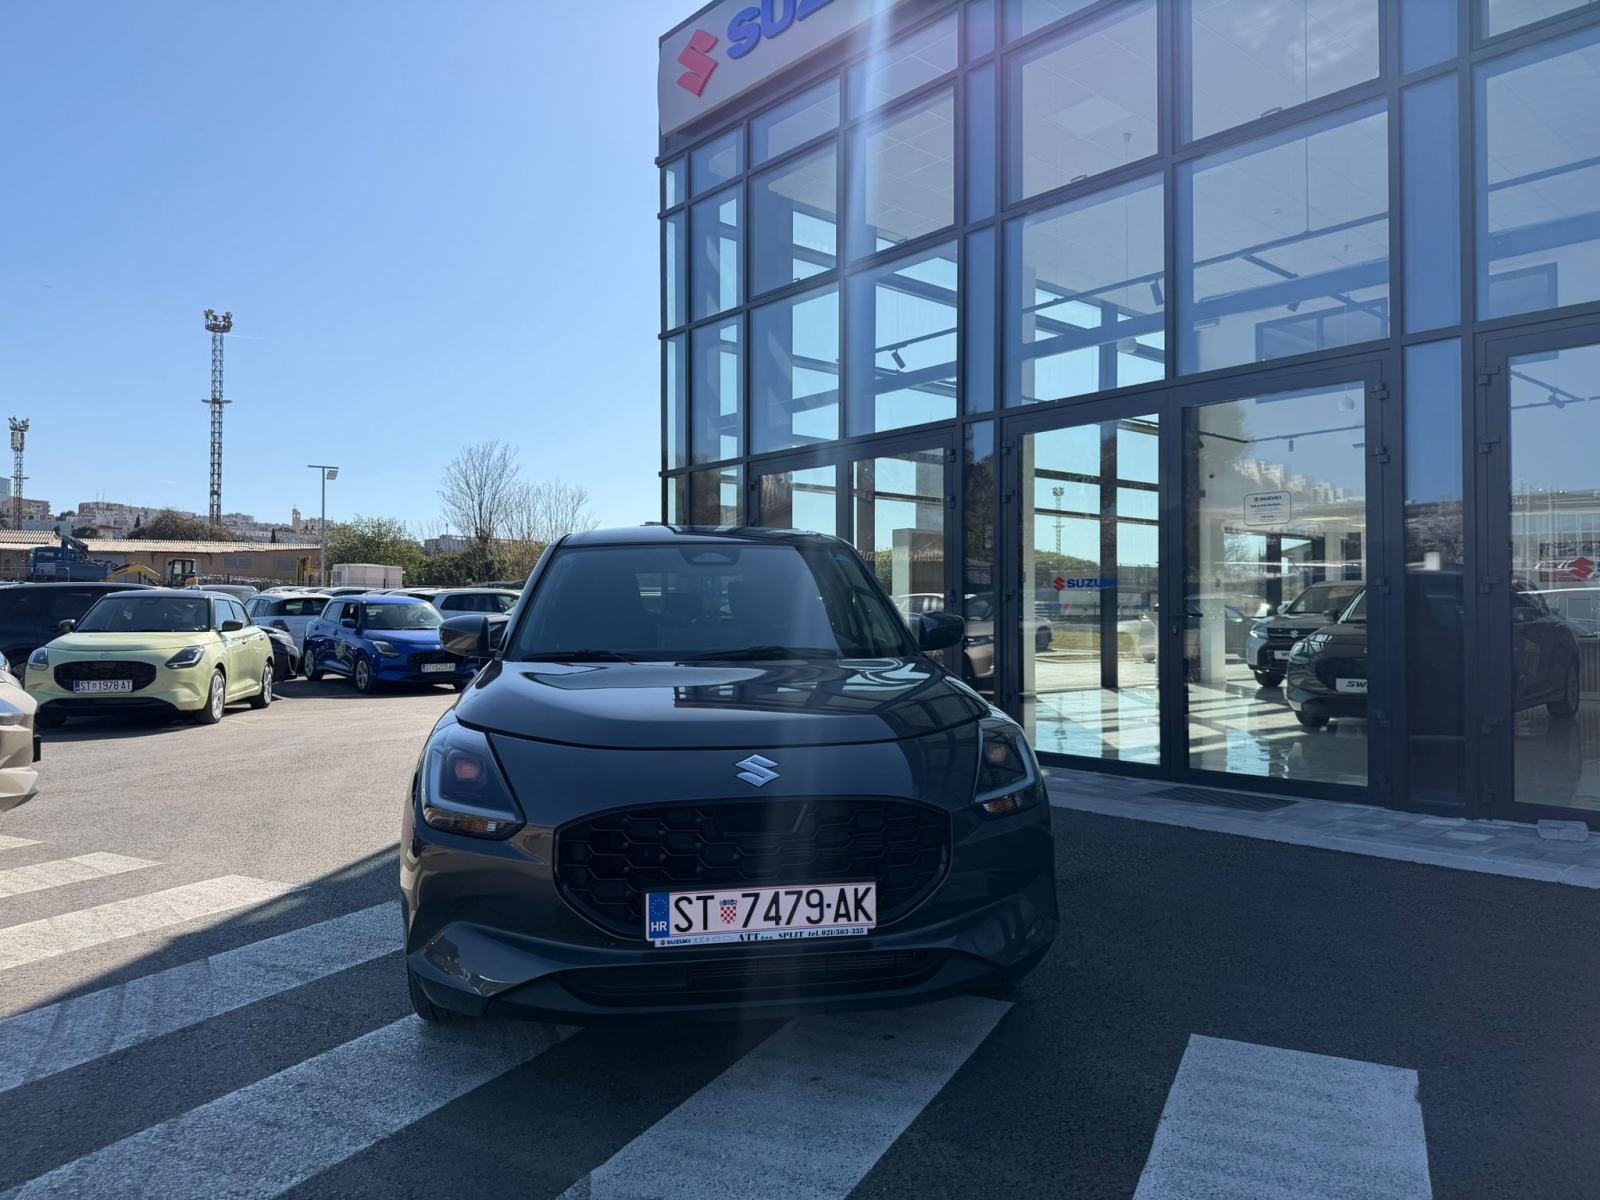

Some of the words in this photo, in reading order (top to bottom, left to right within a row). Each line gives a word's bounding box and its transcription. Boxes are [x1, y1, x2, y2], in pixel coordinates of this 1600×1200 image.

[674, 895, 715, 933] ST
[651, 921, 668, 933] HR
[667, 938, 691, 946] SUZUKI
[778, 931, 805, 939] SPLIT
